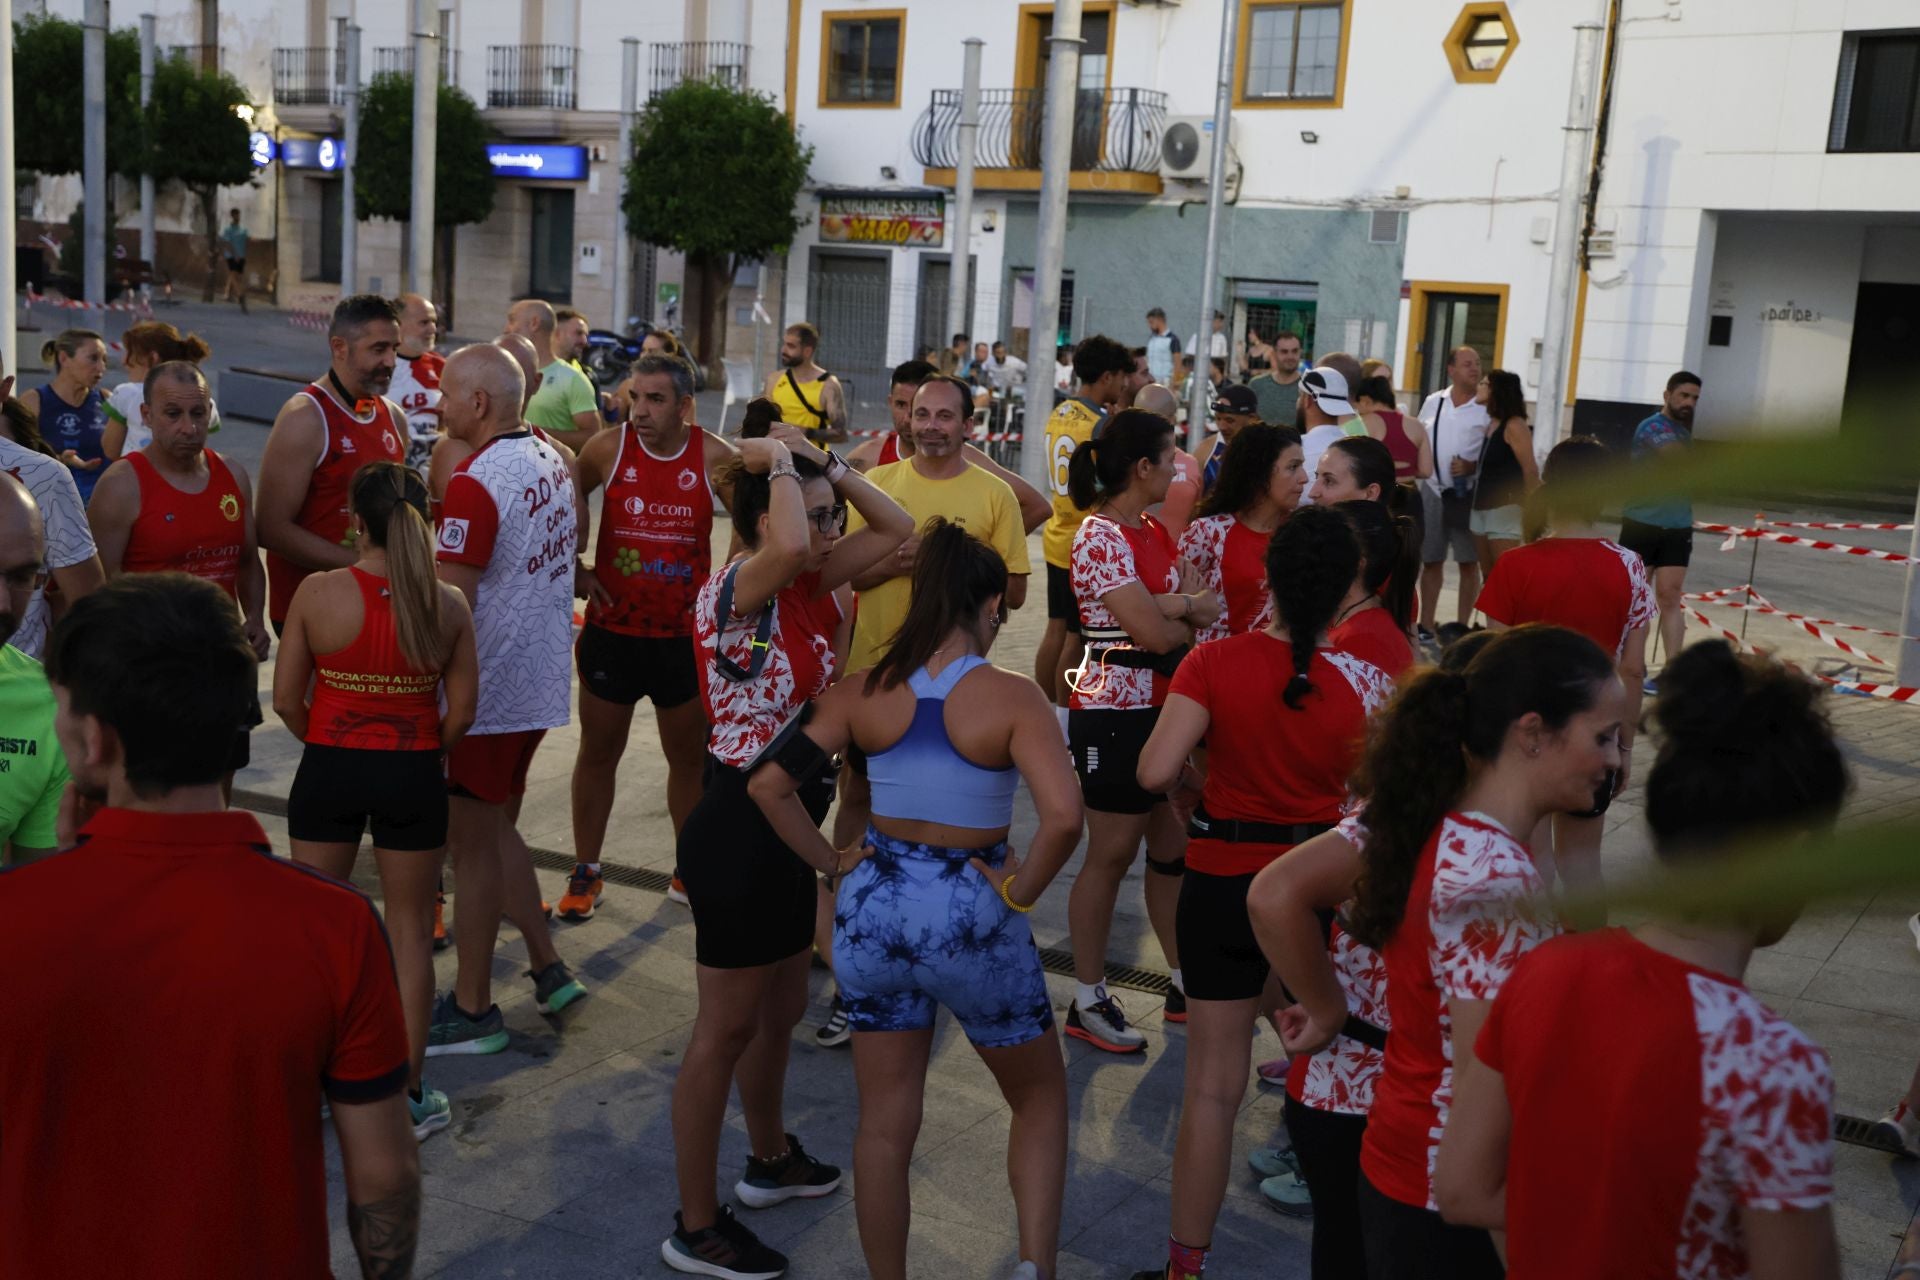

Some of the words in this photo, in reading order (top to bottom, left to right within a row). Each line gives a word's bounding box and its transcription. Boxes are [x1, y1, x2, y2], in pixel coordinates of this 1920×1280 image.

[849, 218, 911, 245] MARIO
[523, 476, 551, 519] 20
[649, 502, 692, 517] cicom
[546, 506, 568, 533] con
[632, 516, 649, 527] Tu
[319, 668, 390, 684] ASOCIACION
[325, 680, 366, 693] CIUDAD
[369, 685, 384, 694] DE
